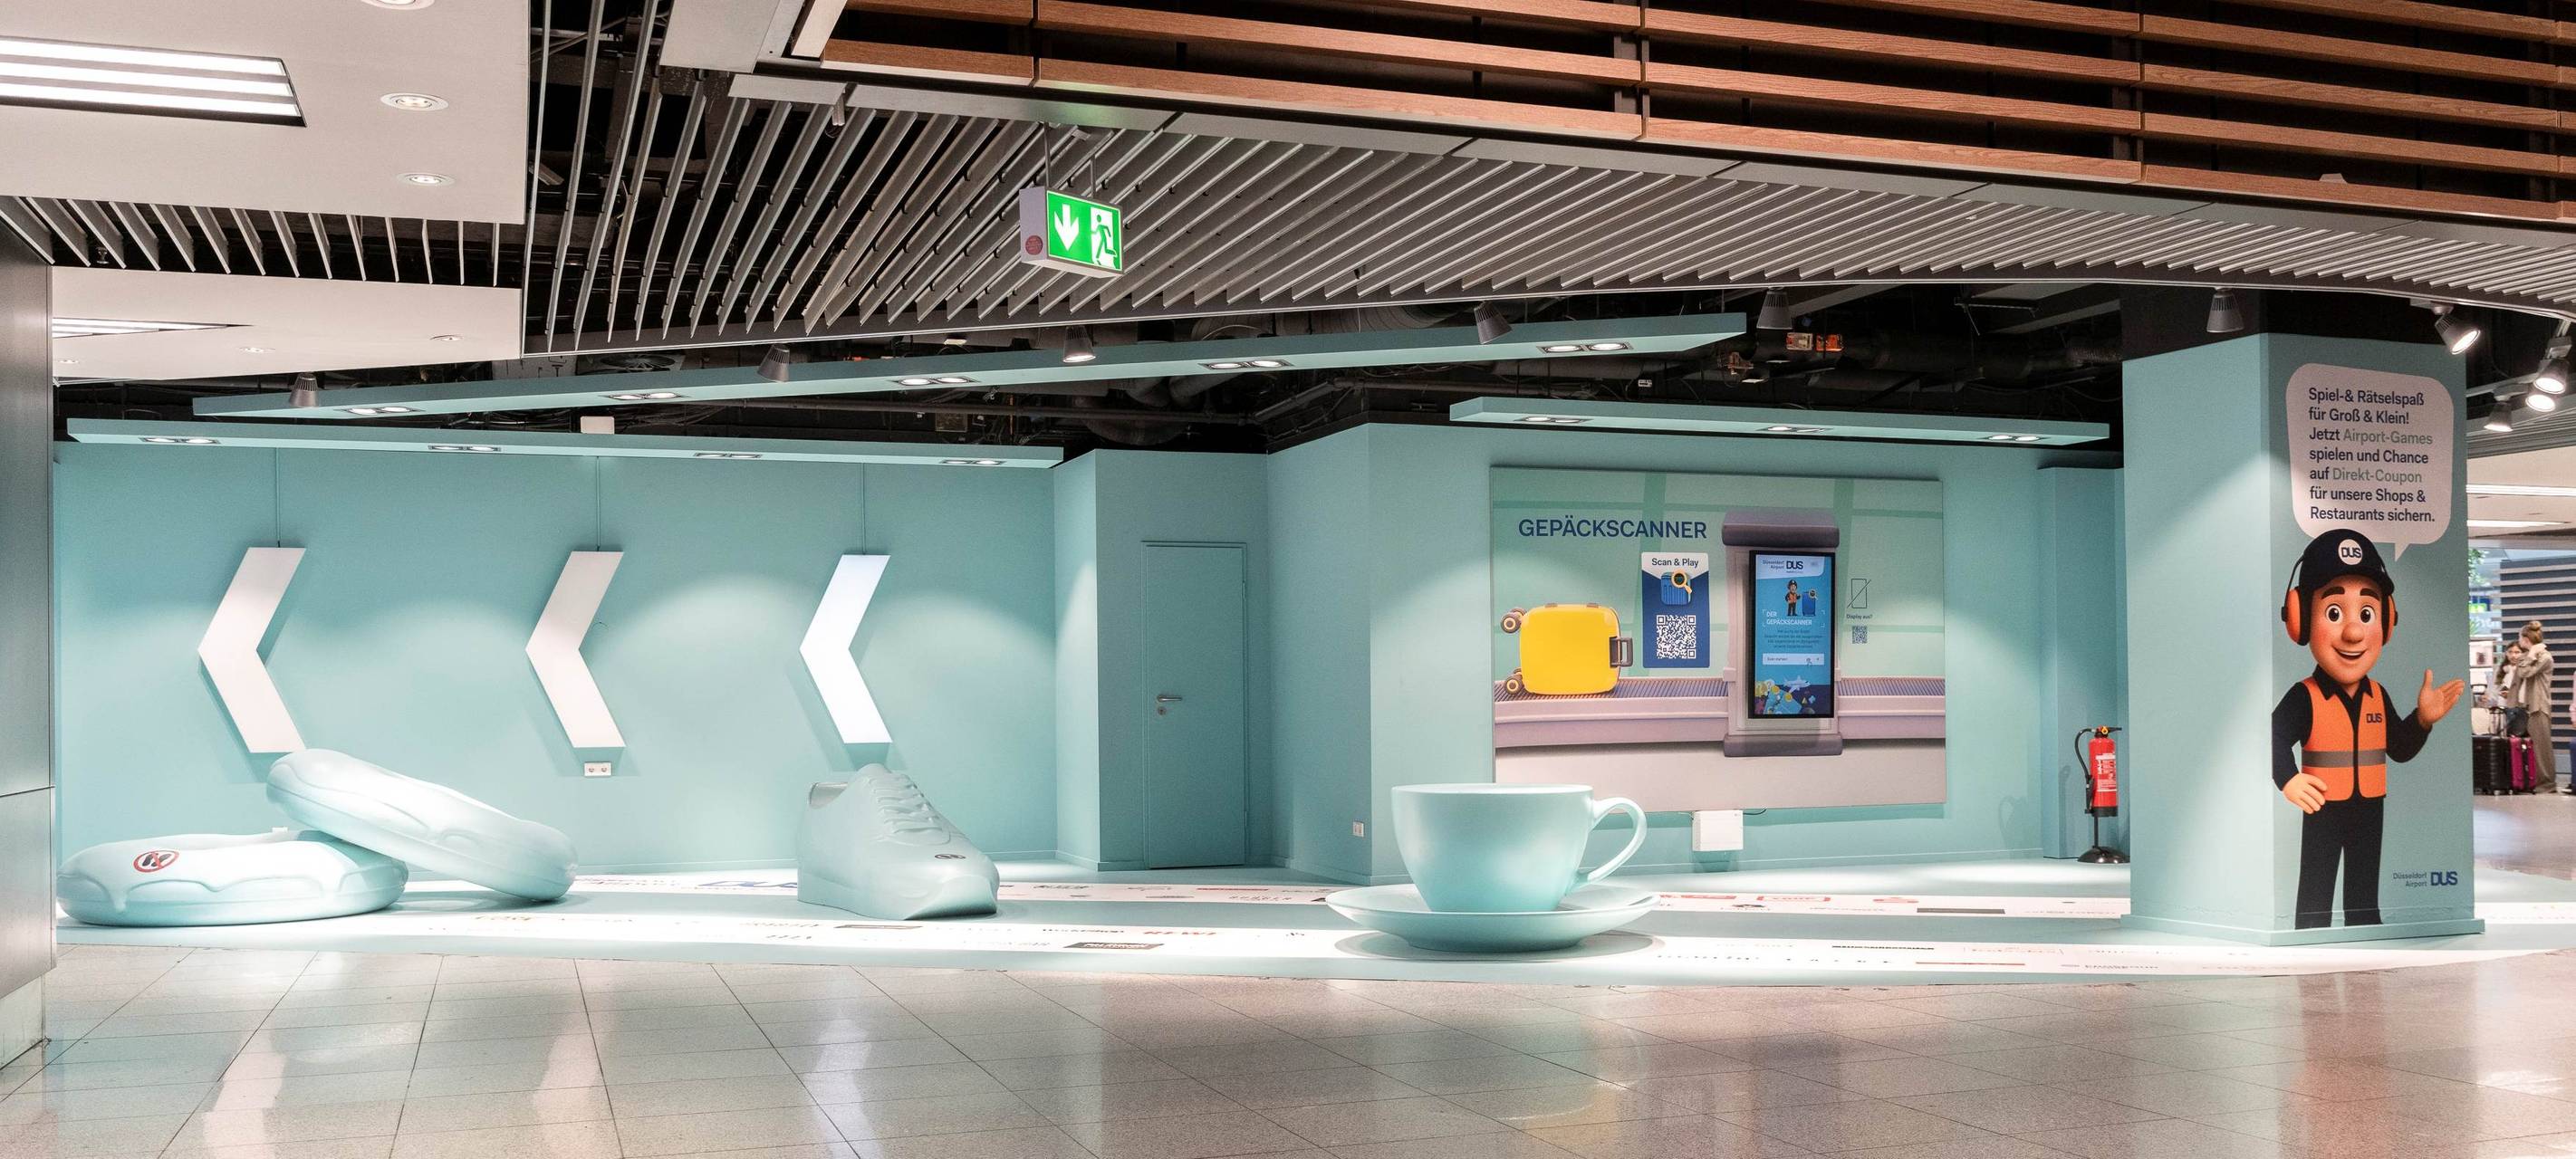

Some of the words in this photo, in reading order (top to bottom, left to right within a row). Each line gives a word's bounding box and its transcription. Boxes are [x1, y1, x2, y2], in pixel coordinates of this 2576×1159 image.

[2357, 389, 2425, 408] Rätselspaß
[2308, 407, 2326, 420] für
[2329, 408, 2360, 422] Groß
[2363, 409, 2373, 423] &
[2376, 410, 2409, 425] Klein!
[2309, 426, 2340, 441] Jetzt
[2343, 428, 2433, 445] Airport-Games
[2310, 446, 2353, 464] spielen
[2357, 449, 2379, 462] und
[2383, 450, 2428, 464] Chance
[2310, 466, 2330, 480] auf
[2332, 467, 2422, 484] Direkt-Coupon
[2310, 486, 2328, 499] für
[2331, 490, 2372, 501] unsere
[2376, 488, 2414, 504] Shops
[2417, 490, 2427, 503] &
[2311, 506, 2385, 521] Restaurants
[2388, 508, 2436, 522] sichern.
[1518, 514, 1707, 539] GEPÄCKSCANNER
[2341, 547, 2362, 558] DUS
[1651, 557, 1672, 566] Scan
[1673, 558, 1680, 566] &
[1682, 558, 1699, 569] Play
[1785, 560, 1804, 570] DUS
[2366, 713, 2383, 723] DUS
[2392, 871, 2427, 879] Düsseldorf
[2430, 871, 2458, 886] DUS
